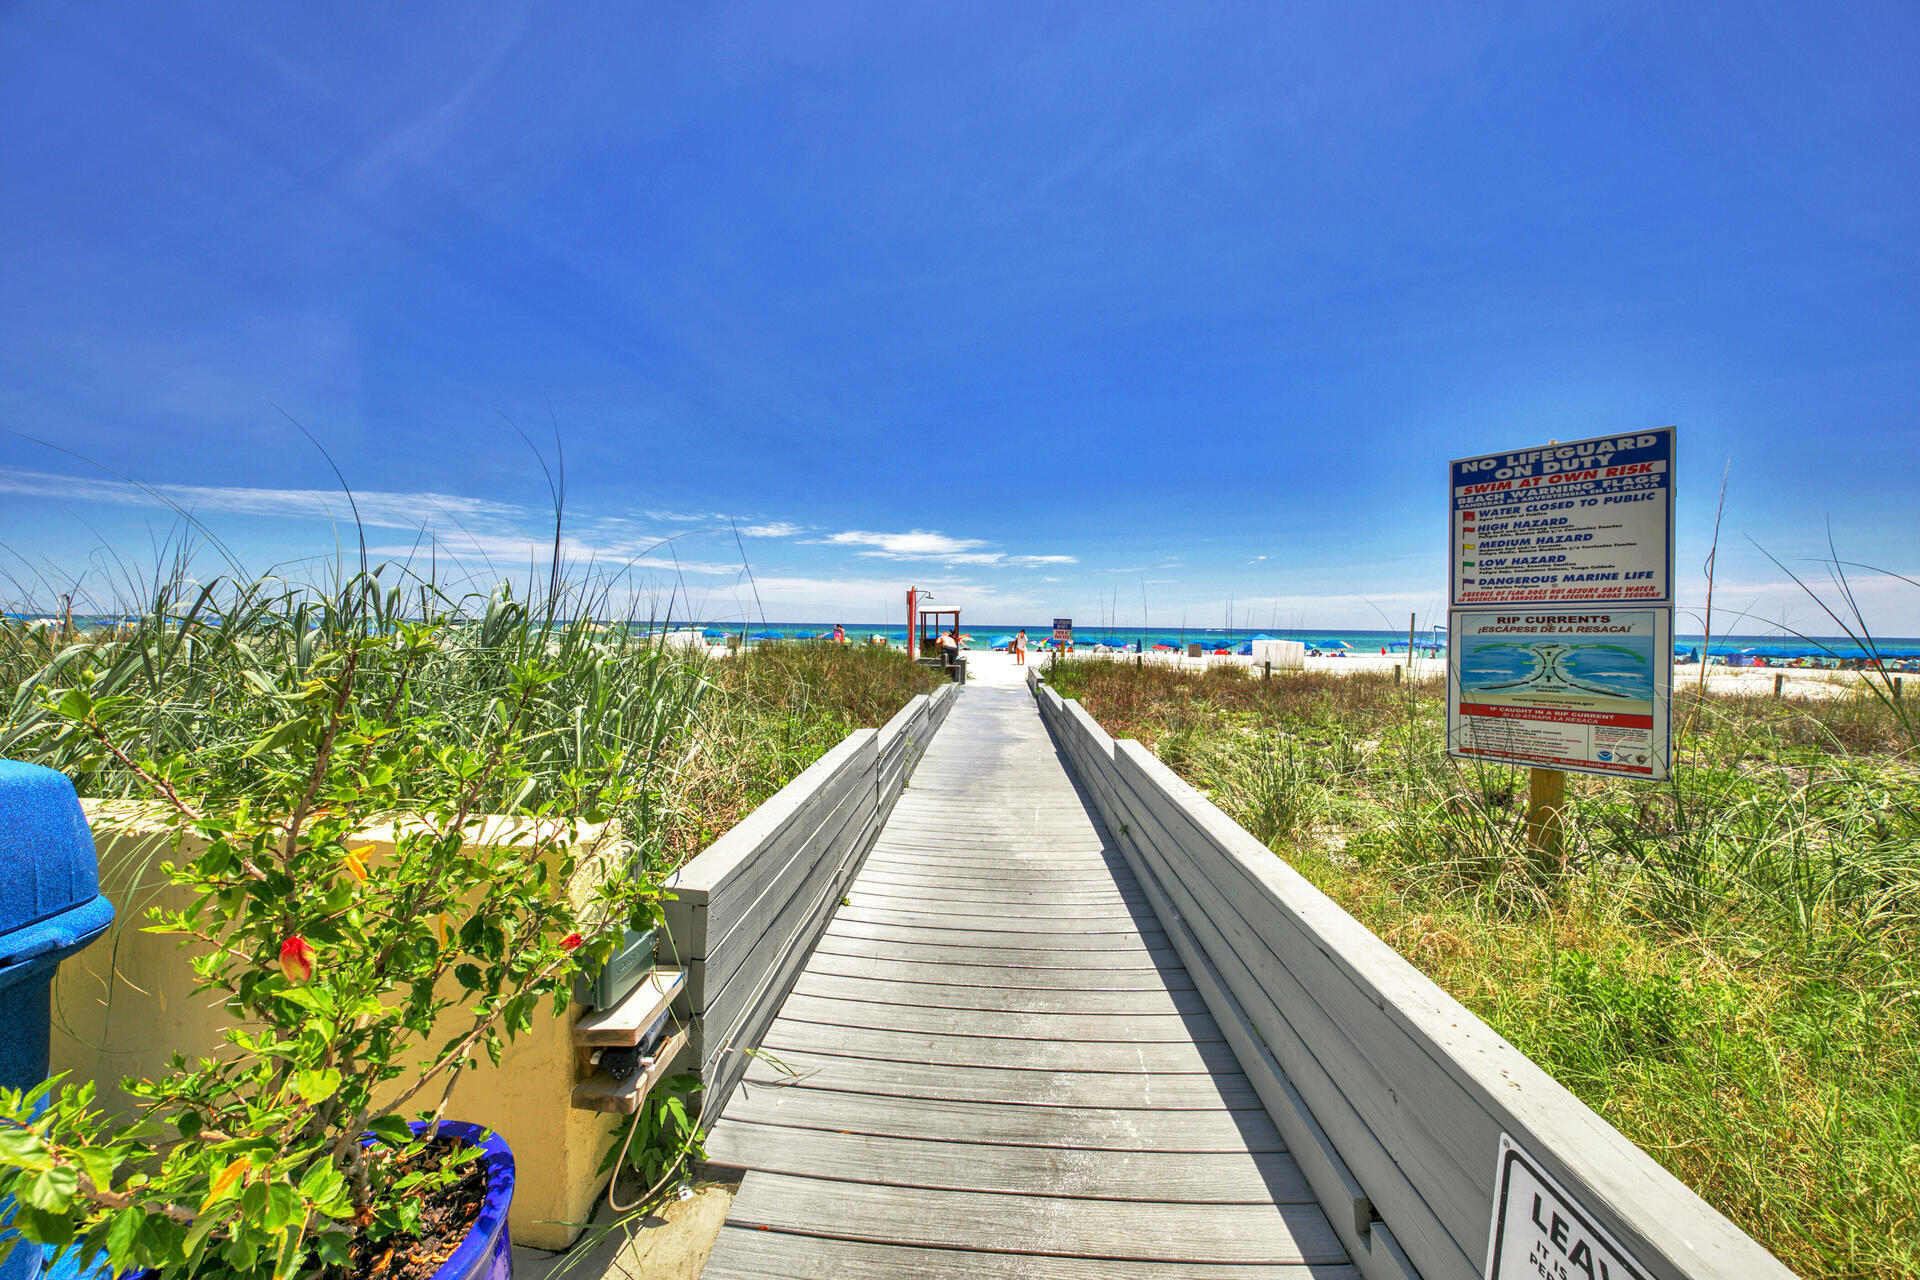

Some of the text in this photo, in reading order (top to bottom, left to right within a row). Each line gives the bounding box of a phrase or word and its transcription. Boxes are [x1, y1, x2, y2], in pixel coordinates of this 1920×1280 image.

[1461, 435, 1657, 474] NO LIFEGUARD
[1494, 453, 1614, 479] ON DUTY
[1464, 462, 1655, 495] SWIM AT OWN RISK
[1458, 474, 1661, 505] BEACH WARNING FLAGS
[1459, 499, 1504, 509] BANDERAS
[1623, 482, 1659, 490] PLAYA
[1479, 492, 1655, 517] WATER CLOSED TO PUBLIC
[1477, 517, 1568, 532] HIGH HAZARD
[1479, 533, 1593, 549] MEDIUM HAZARD
[1478, 554, 1566, 567] LOW HAZARD
[1478, 570, 1655, 586] DANGEROUS MARINE LIFE
[1566, 586, 1599, 594] ASSURE
[1496, 615, 1611, 624] RIP CURRENTS
[1478, 625, 1538, 634] ¡ESCÁPESE
[1540, 625, 1556, 633] DE
[1575, 625, 1632, 633] RESACA!
[1500, 706, 1532, 714] CAUGHT
[1571, 712, 1615, 720] CURRENT
[1536, 1239, 1567, 1280] IT IS
